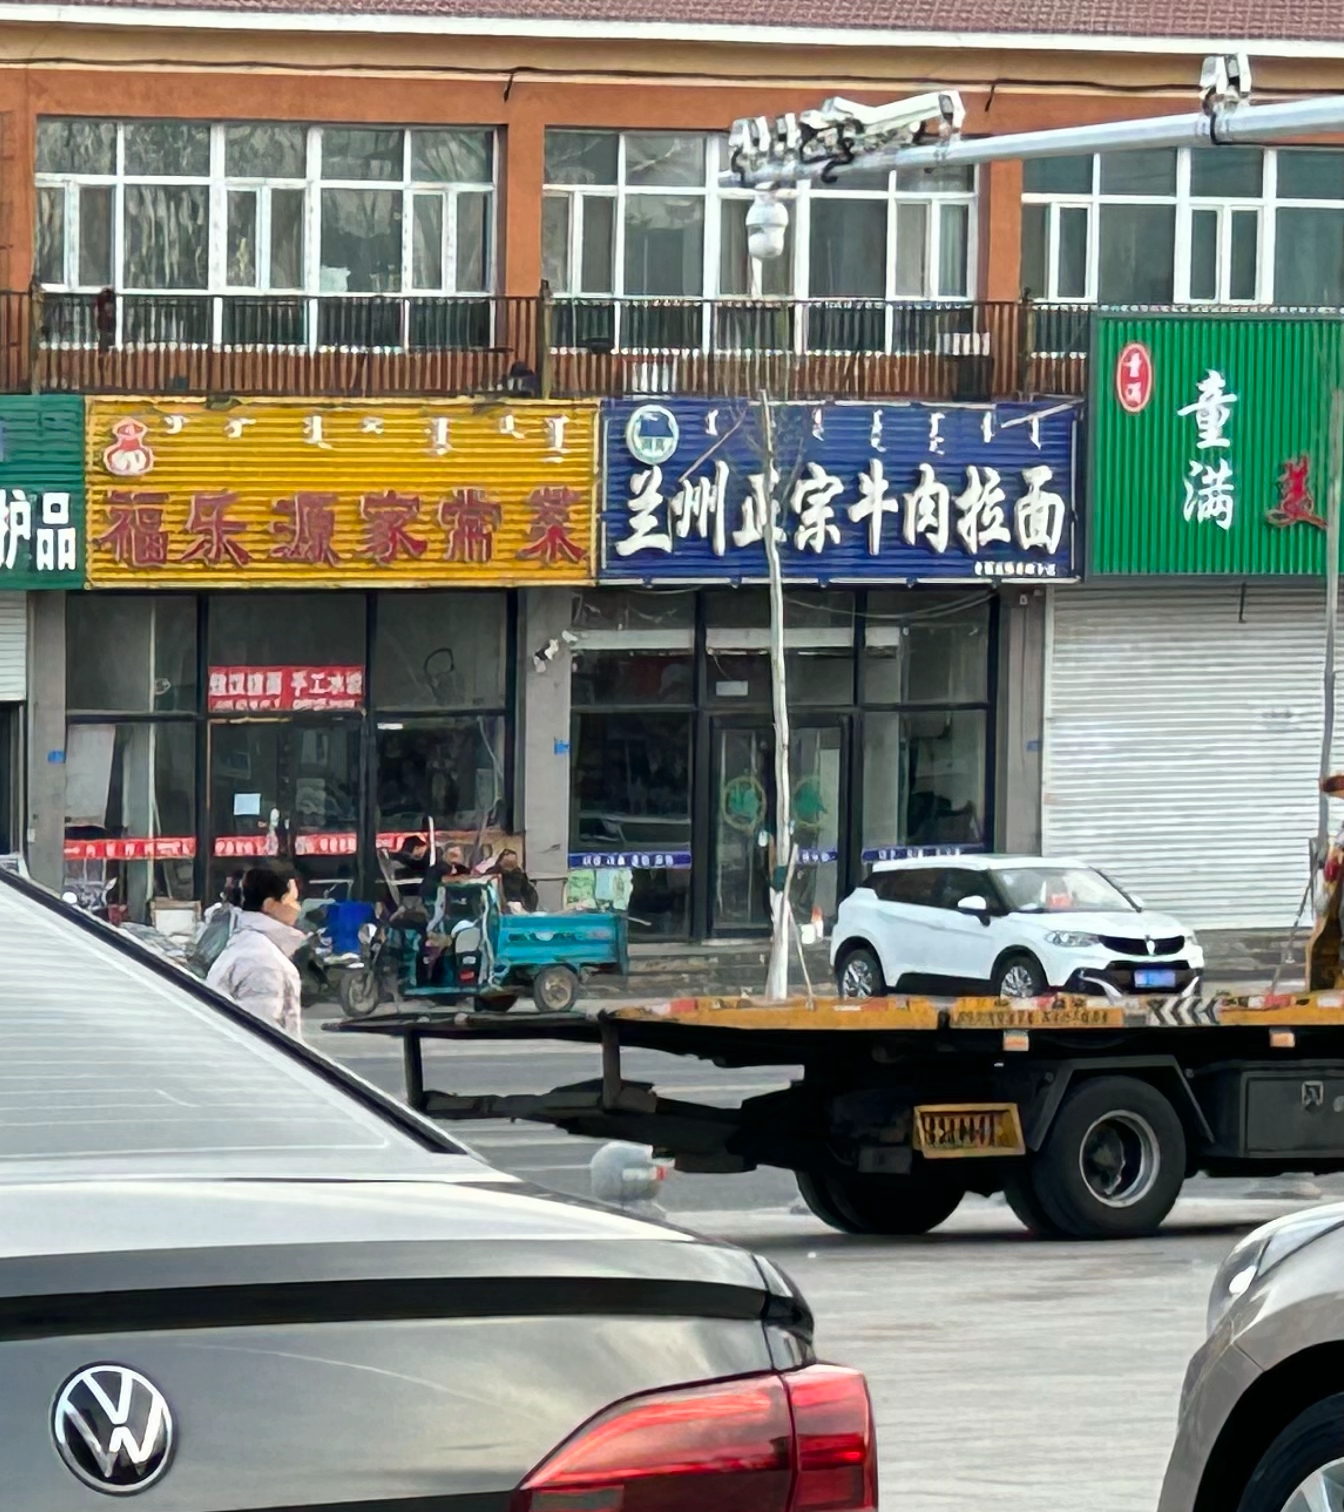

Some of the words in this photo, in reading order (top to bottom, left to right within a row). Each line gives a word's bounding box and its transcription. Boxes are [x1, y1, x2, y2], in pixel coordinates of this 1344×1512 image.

[615, 458, 1067, 557] 兰州正宗牛肉拉面
[1177, 368, 1238, 531] 童满
